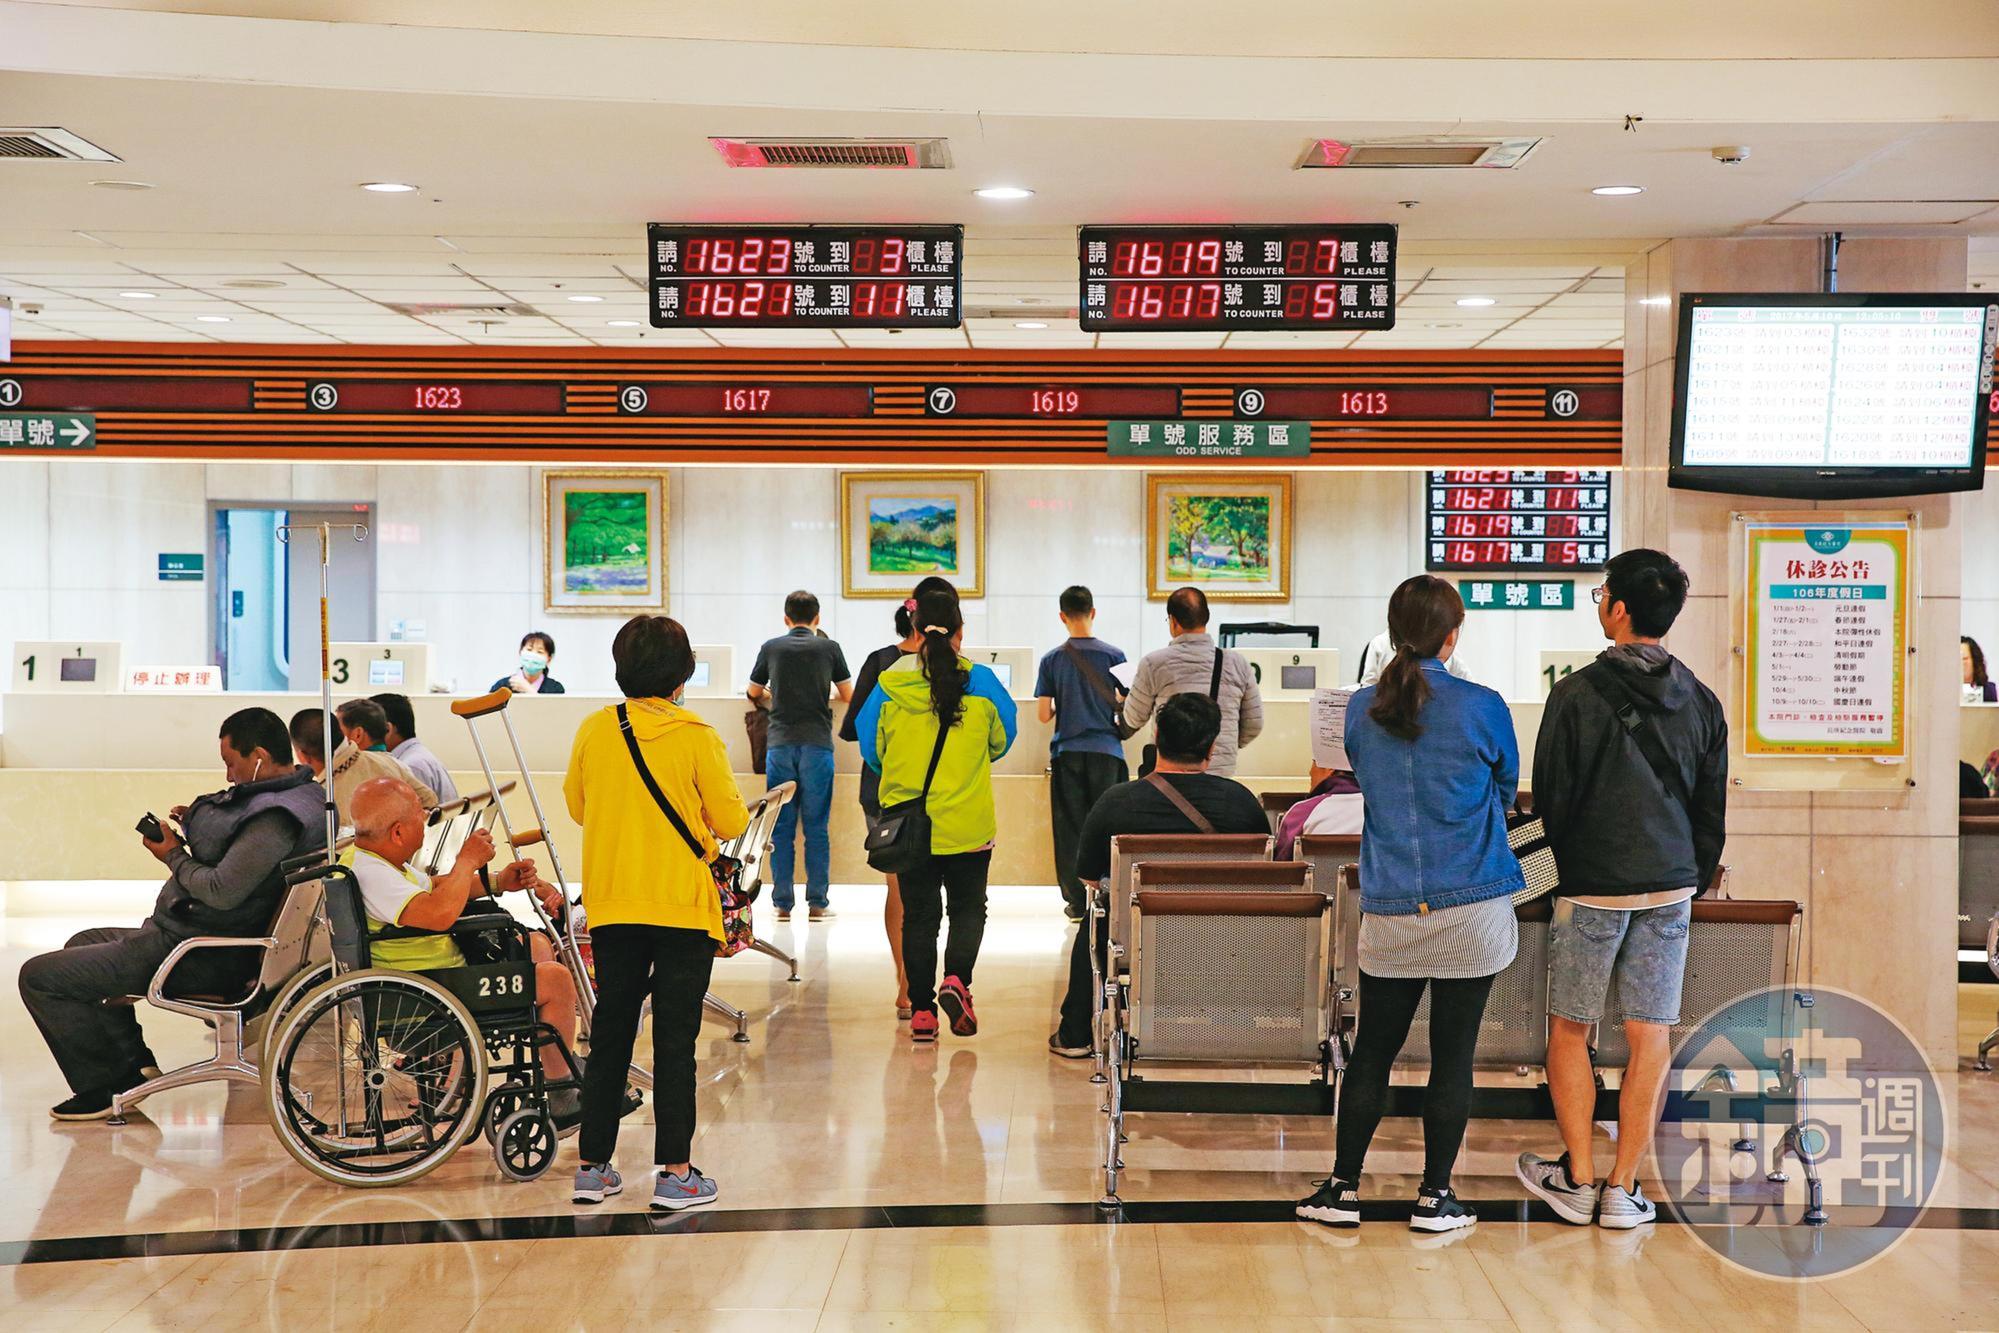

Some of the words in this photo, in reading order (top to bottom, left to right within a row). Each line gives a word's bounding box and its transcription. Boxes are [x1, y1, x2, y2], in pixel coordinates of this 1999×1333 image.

[658, 241, 678, 263] 請
[699, 240, 790, 272] 1623
[881, 240, 904, 272] 3
[1088, 241, 1106, 263] 請
[1128, 241, 1220, 274] 1619
[1318, 240, 1339, 272] 7
[1225, 267, 1238, 275] TO
[1240, 267, 1284, 275] COUNTER
[1344, 267, 1386, 275] PLEASE
[658, 286, 679, 309] 請
[700, 283, 792, 316] 1621
[867, 284, 903, 316] 11
[1088, 285, 1106, 306] 請
[1128, 284, 1220, 317] 1617
[1314, 284, 1336, 317] 5
[795, 308, 807, 316] TO
[808, 308, 850, 316] COUNTER
[911, 308, 949, 316] PLEASE
[1224, 310, 1238, 318] TO
[1239, 310, 1284, 318] COUNTER
[1343, 310, 1385, 318] PLEASE
[415, 387, 462, 408] 1623
[724, 390, 771, 411] 1617
[1032, 391, 1079, 412] 1619
[1341, 393, 1388, 414] 1613
[0, 420, 54, 445] 單號
[1129, 424, 1289, 446] 單號服務區
[1176, 447, 1197, 455] ODD
[1201, 447, 1242, 455] SERVICE
[1455, 488, 1510, 509] 1621
[1555, 489, 1577, 509] 11
[1455, 515, 1510, 535] 1619
[1566, 516, 1577, 535] 7
[1454, 542, 1509, 562] 1617
[1562, 542, 1577, 563] 5
[1786, 560, 1870, 580] 休診公告
[1471, 583, 1563, 606] 單號區
[1793, 587, 1863, 599] 106年度假日
[22, 655, 35, 681] 1
[332, 658, 349, 684] 3
[384, 649, 391, 659] 3
[1292, 654, 1300, 665] 9
[133, 671, 211, 686] 停止辦理
[479, 974, 523, 996] 238
[1339, 1190, 1359, 1202] NIK
